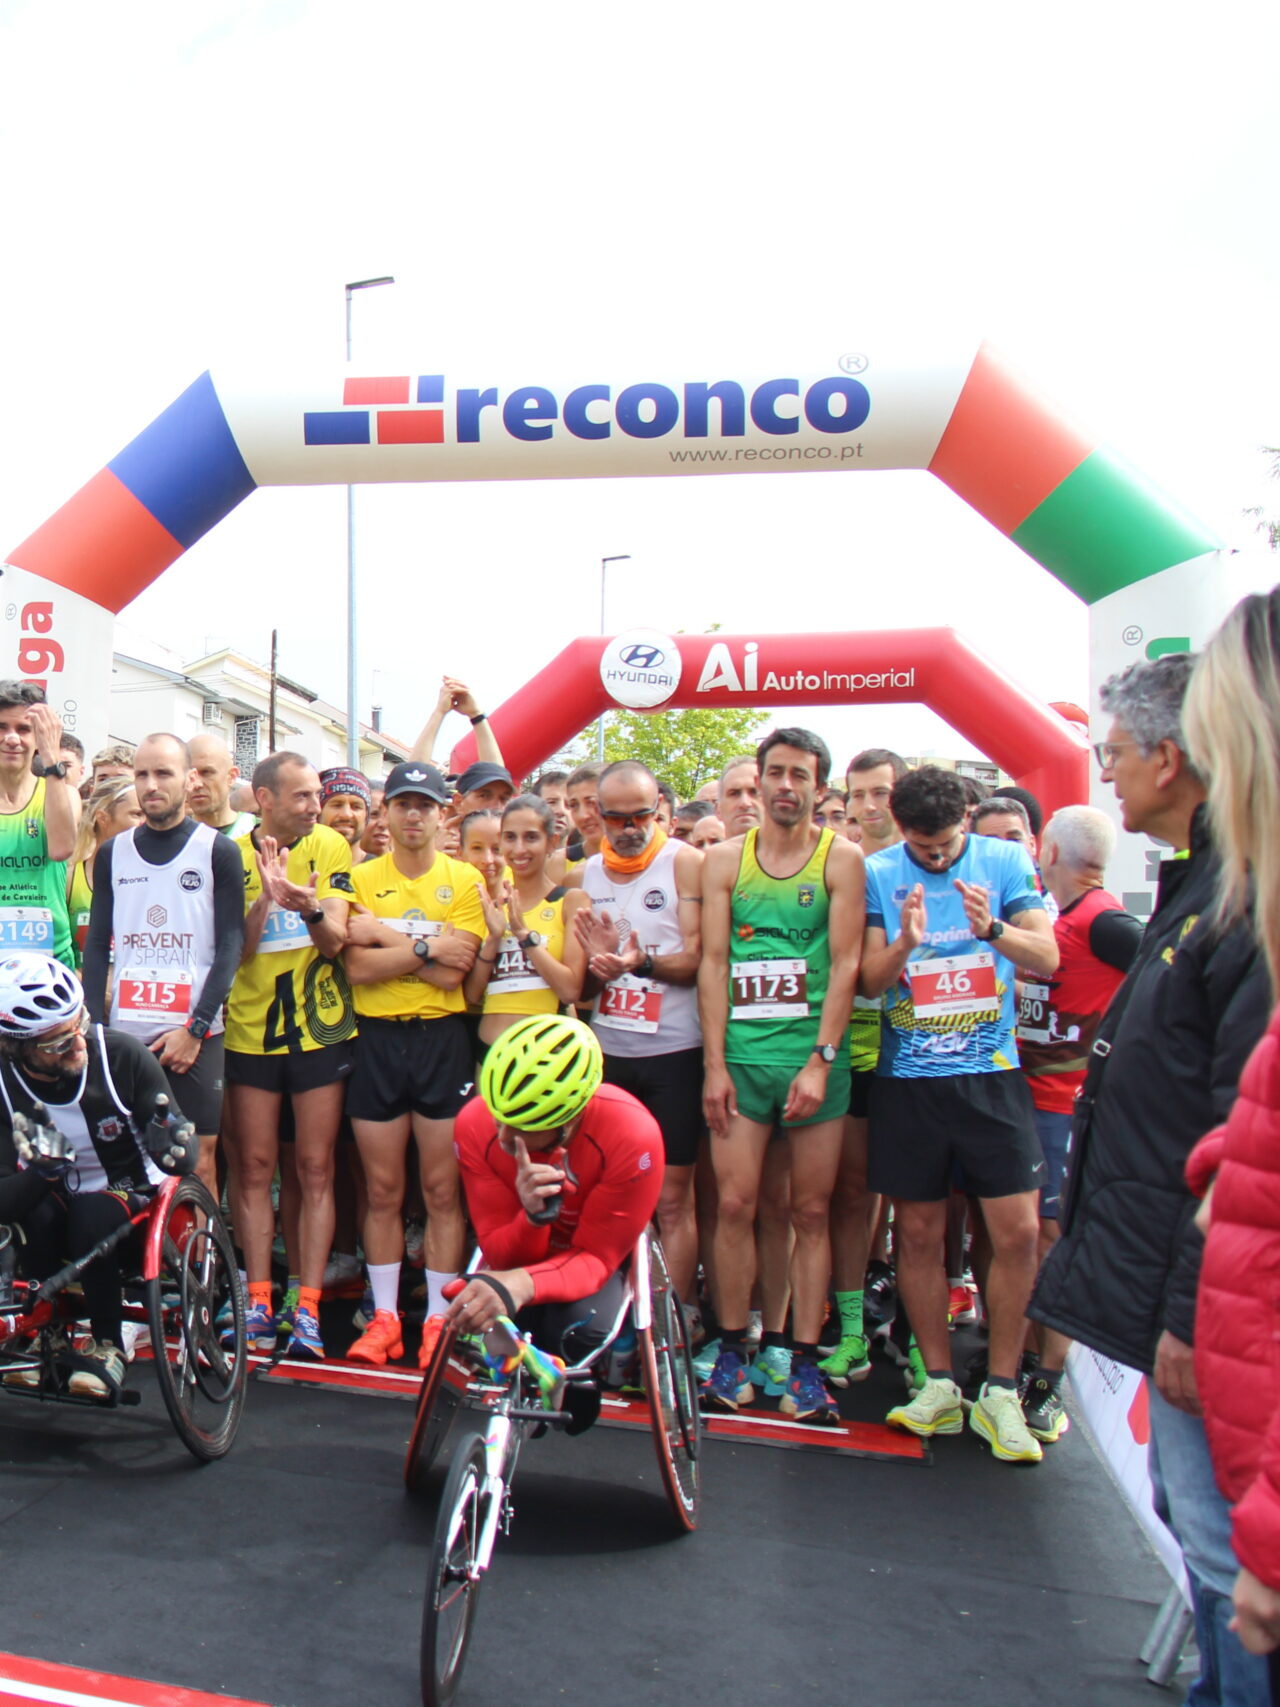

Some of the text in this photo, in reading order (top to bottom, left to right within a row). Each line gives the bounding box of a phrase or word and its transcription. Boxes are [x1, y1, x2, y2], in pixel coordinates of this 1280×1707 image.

[456, 376, 871, 443] reconco
[669, 443, 864, 463] www.reconco.pt
[607, 670, 673, 687] HYUNDAI
[1, 893, 10, 901] de
[123, 932, 194, 949] PREVENT
[135, 948, 197, 966] SPRAIN
[738, 974, 799, 998] 1173
[936, 970, 971, 994] 46
[131, 982, 176, 1004] 215
[606, 987, 647, 1012] 212
